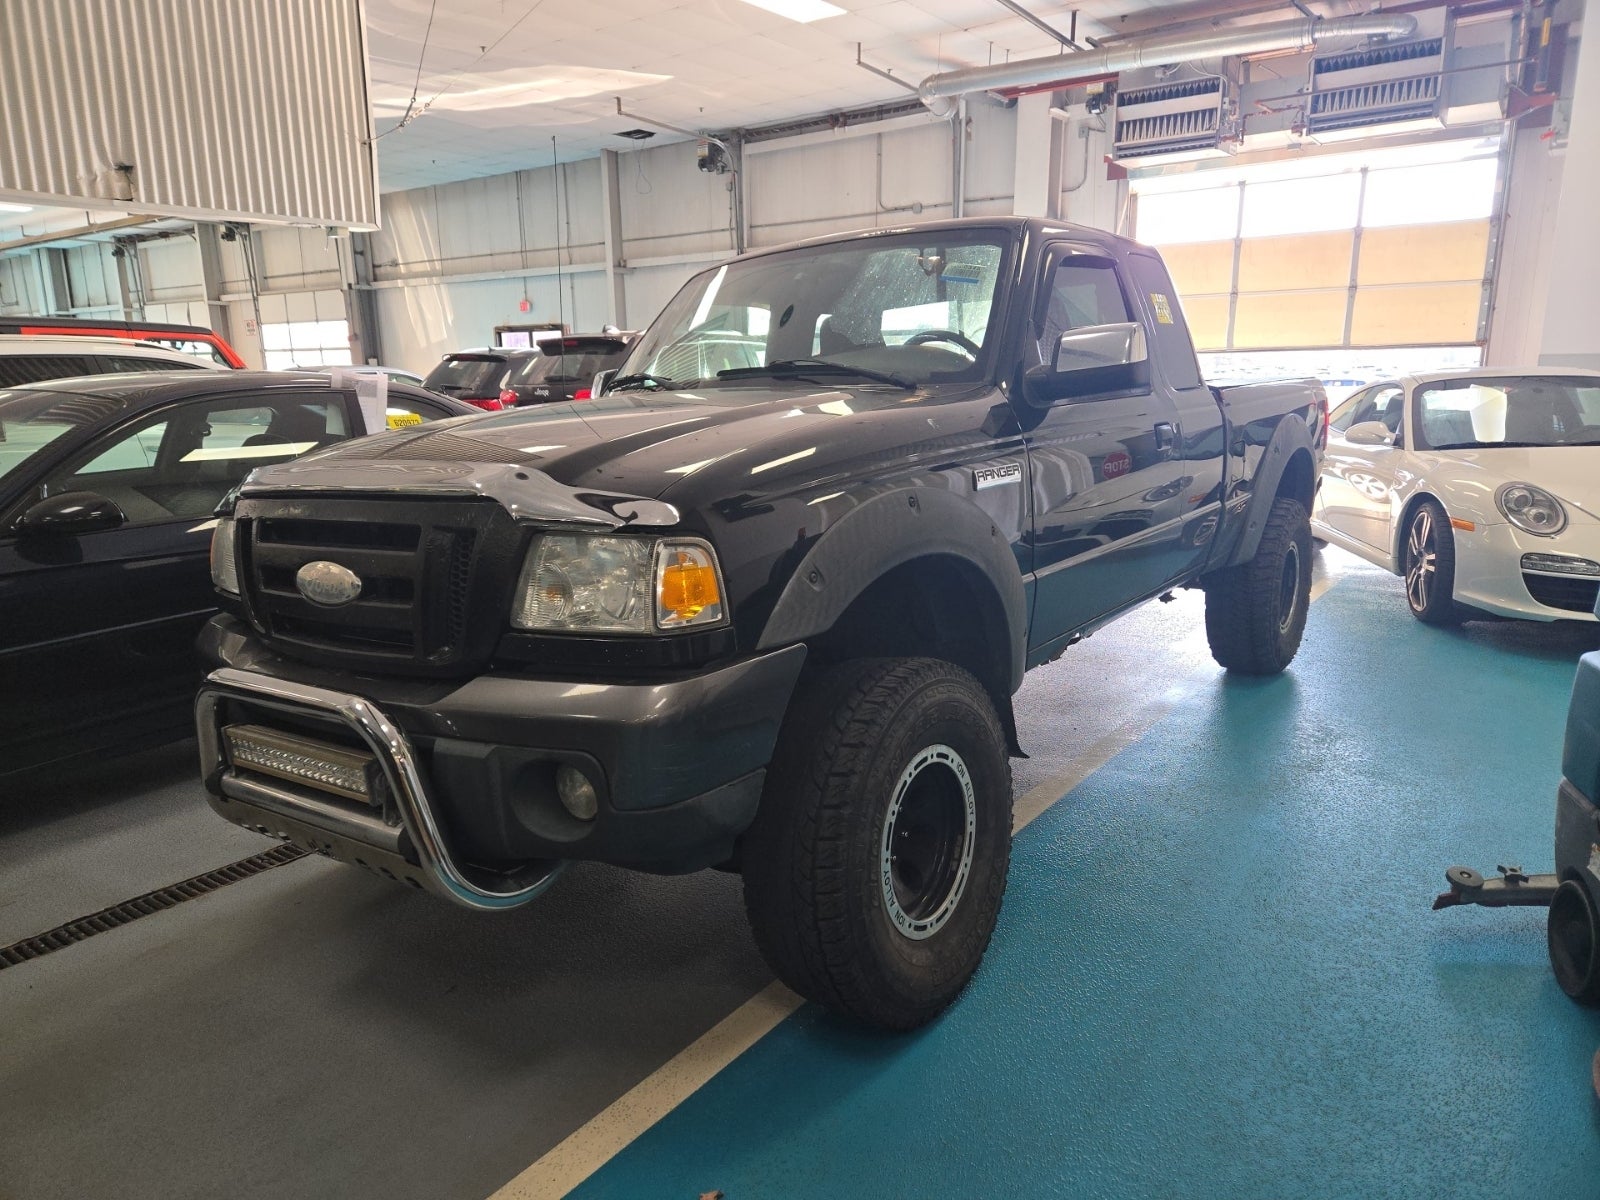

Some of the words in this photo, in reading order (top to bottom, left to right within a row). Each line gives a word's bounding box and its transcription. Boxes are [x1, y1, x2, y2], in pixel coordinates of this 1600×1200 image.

[534, 388, 550, 397] Jeep
[977, 464, 1021, 482] RANGER
[957, 762, 966, 778] ION
[965, 782, 974, 815] ALLOY
[883, 870, 896, 907] ALLOY
[895, 910, 906, 927] ION
